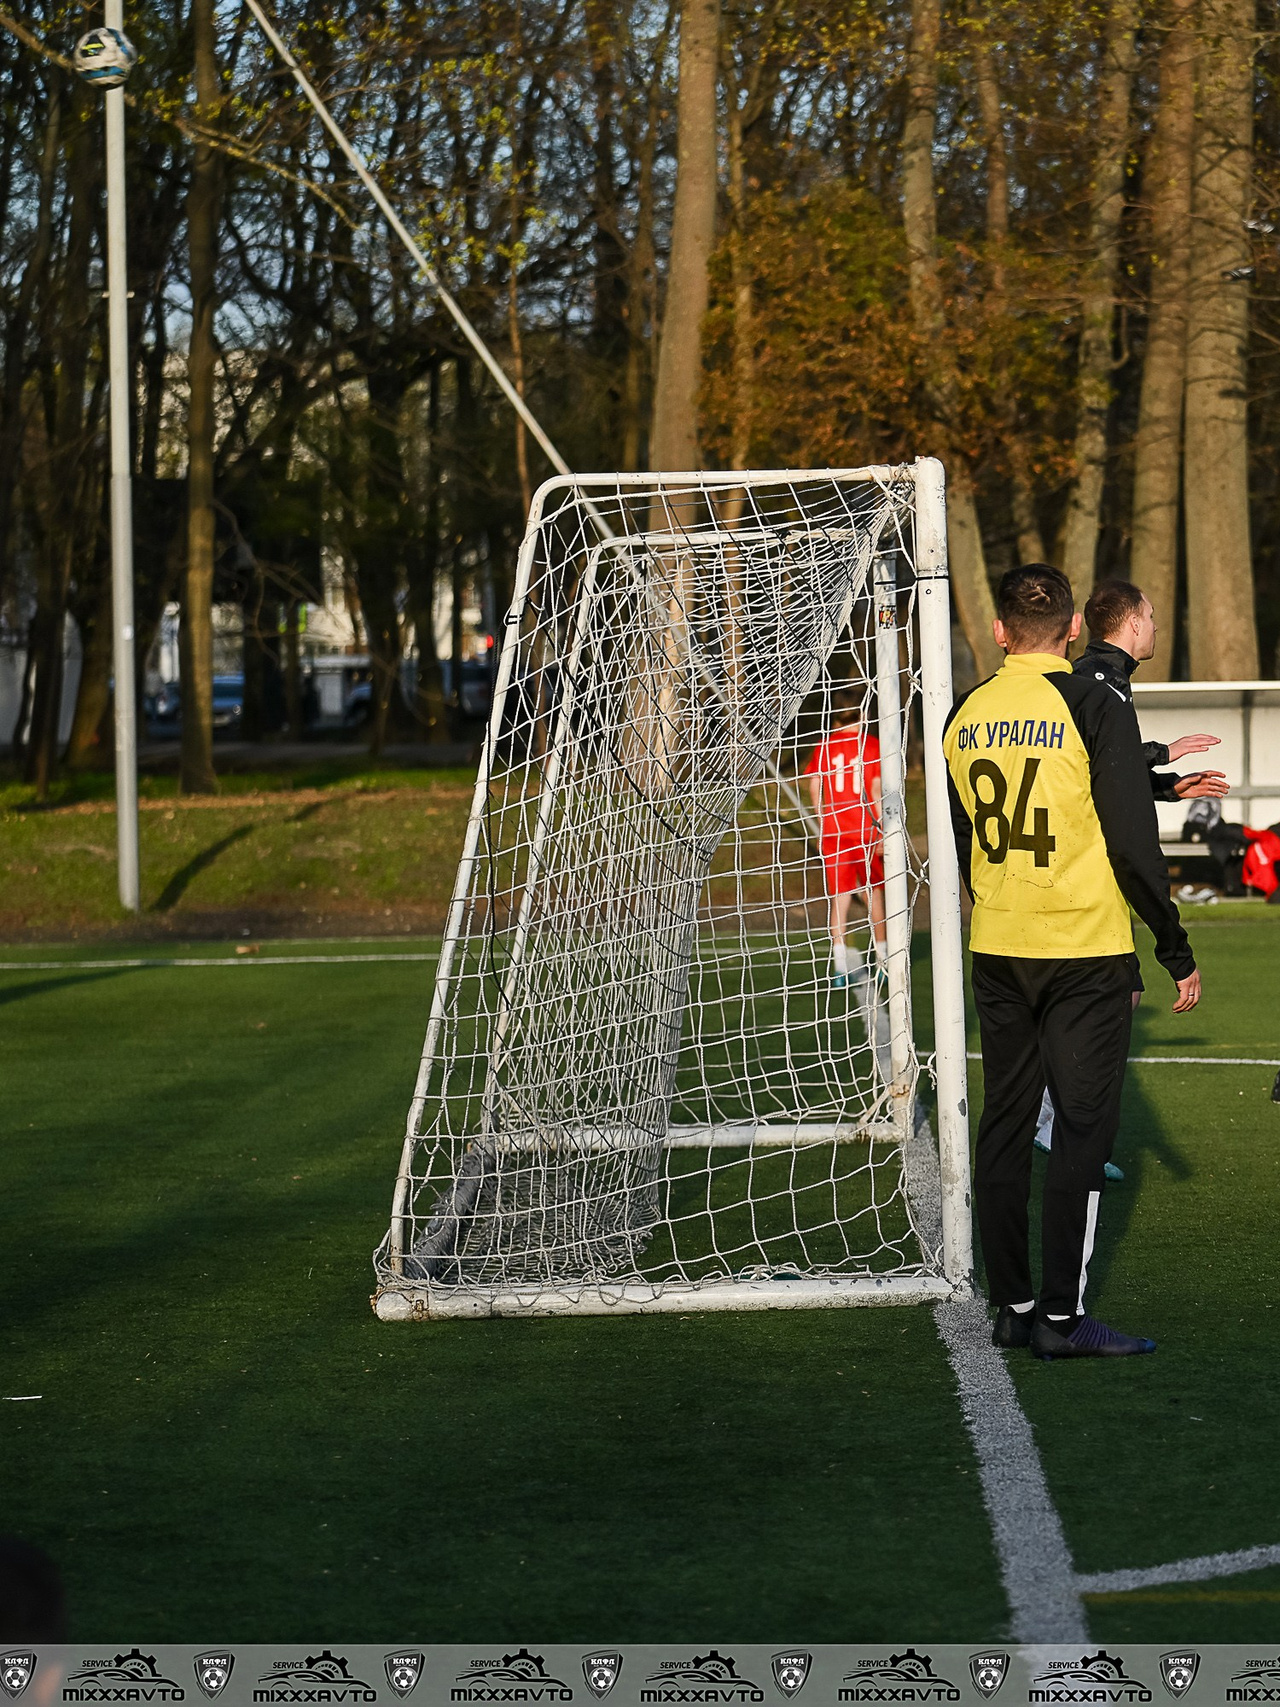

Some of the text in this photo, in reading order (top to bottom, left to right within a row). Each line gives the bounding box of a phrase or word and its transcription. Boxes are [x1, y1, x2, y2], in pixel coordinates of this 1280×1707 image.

[958, 719, 1065, 751] ФК УРАЛАН
[832, 753, 863, 795] 11
[968, 757, 1056, 868] 84
